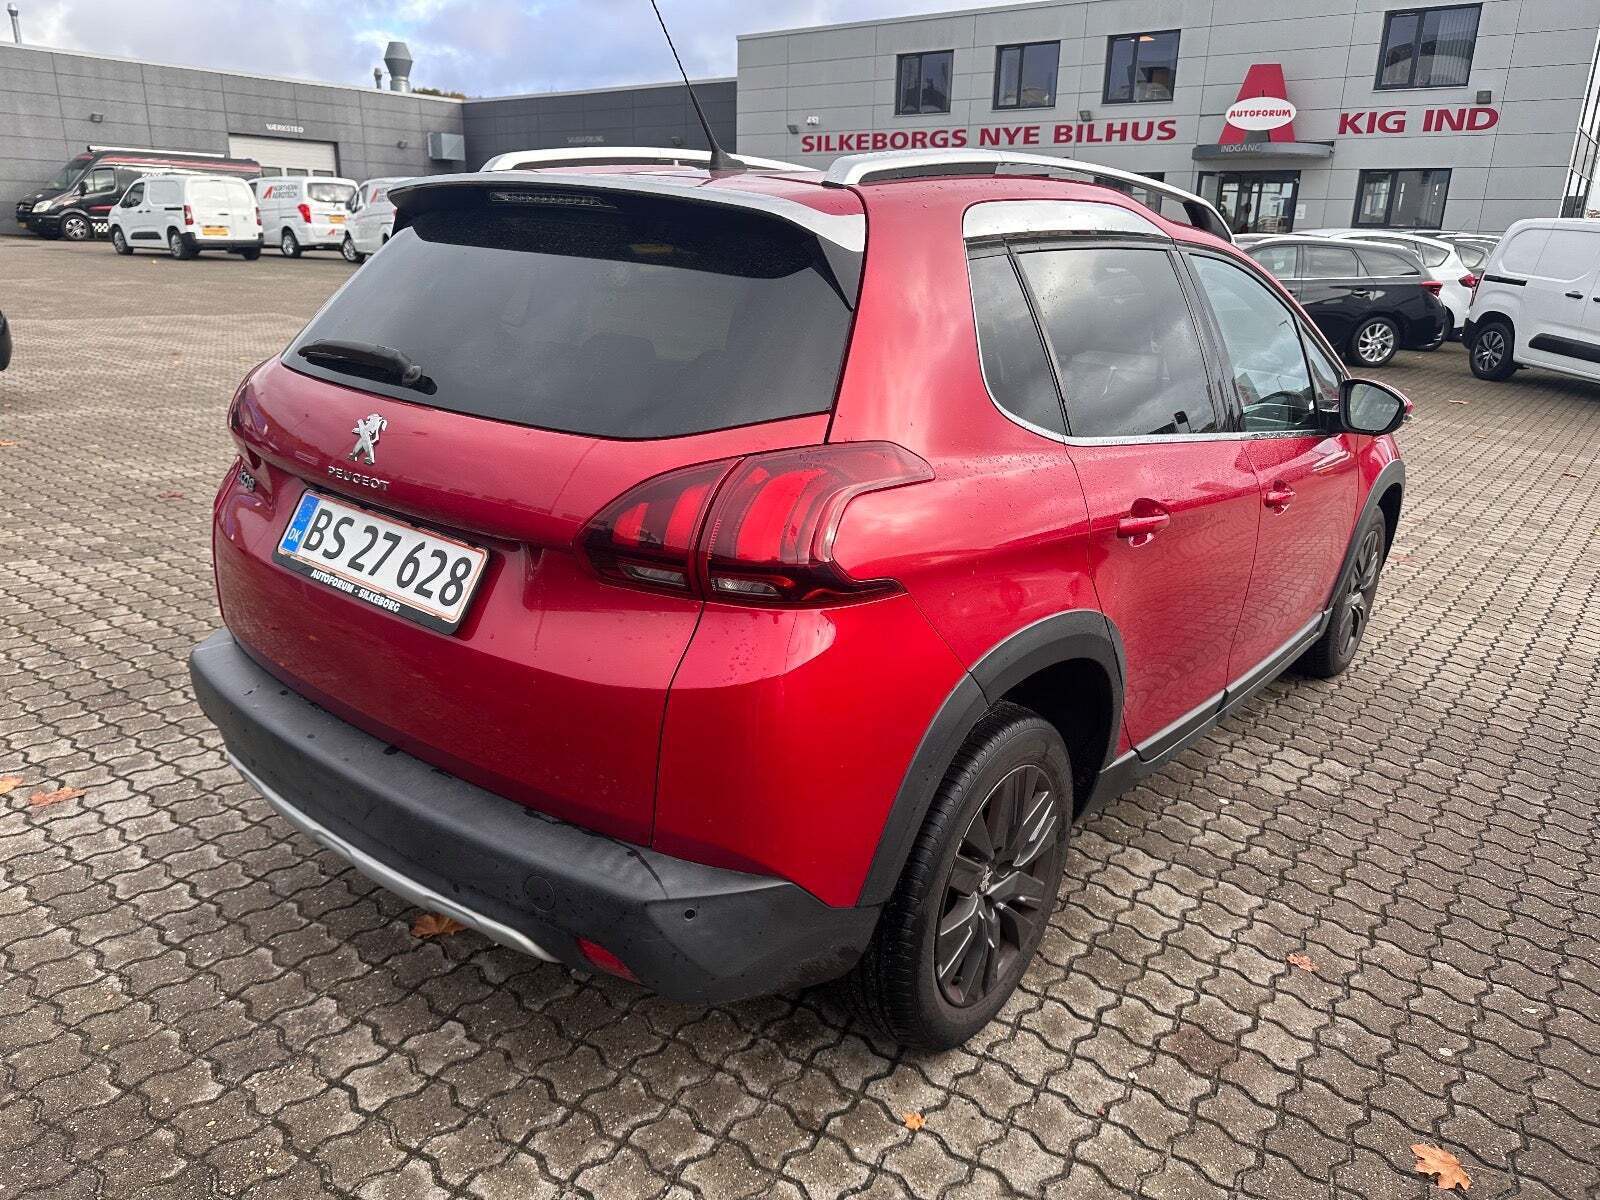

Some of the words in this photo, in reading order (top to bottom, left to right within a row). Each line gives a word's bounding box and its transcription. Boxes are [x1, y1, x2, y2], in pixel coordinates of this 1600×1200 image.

[1229, 108, 1292, 119] AUTOFORUM
[1338, 110, 1407, 135] KIG
[1422, 107, 1499, 132] IND
[801, 128, 968, 153] SILKEBORGS
[979, 126, 1041, 146] NYE
[1053, 119, 1177, 144] BILHUS
[1220, 143, 1261, 153] INDGANG
[327, 465, 390, 491] PEUGEOT
[287, 527, 304, 543] DK
[302, 507, 355, 560] BS
[347, 524, 402, 577] 27
[396, 541, 472, 607] 628
[310, 569, 355, 593] AUTOFORUM
[358, 588, 401, 613] SILKEBORG
